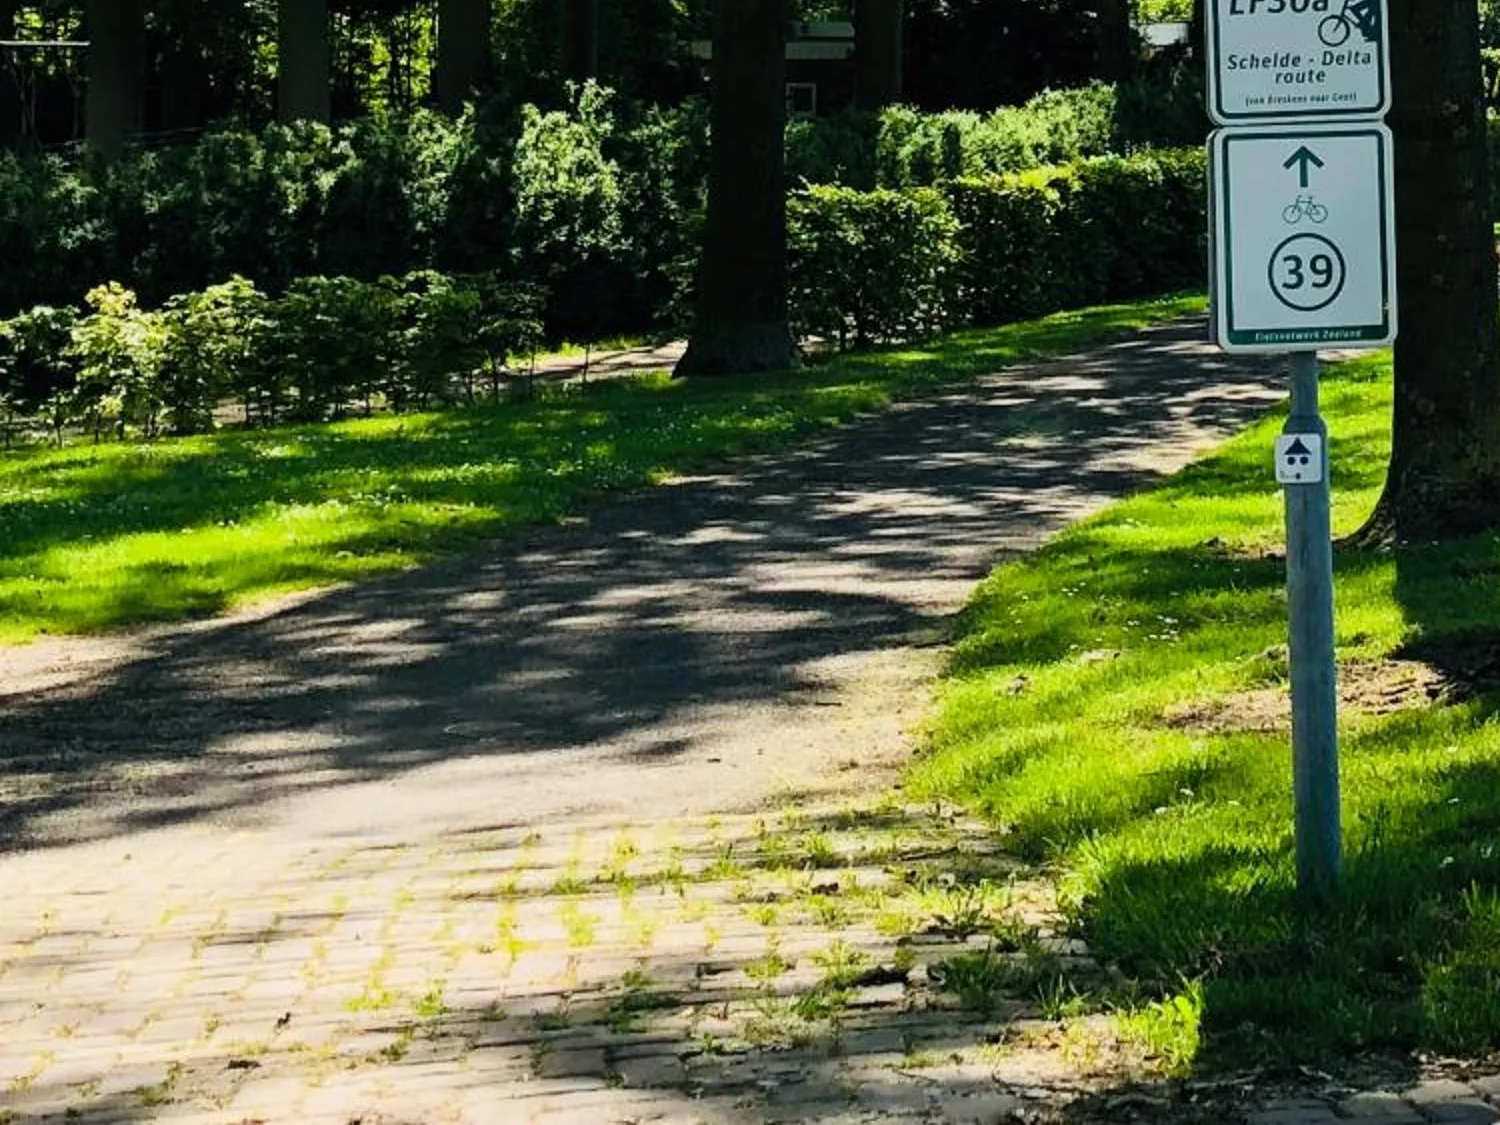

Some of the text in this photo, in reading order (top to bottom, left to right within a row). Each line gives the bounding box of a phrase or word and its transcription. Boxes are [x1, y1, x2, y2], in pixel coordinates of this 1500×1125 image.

[1227, 53, 1301, 70] Schelde
[1322, 50, 1371, 66] Delta
[1275, 69, 1326, 84] route
[1282, 254, 1333, 290] 39
